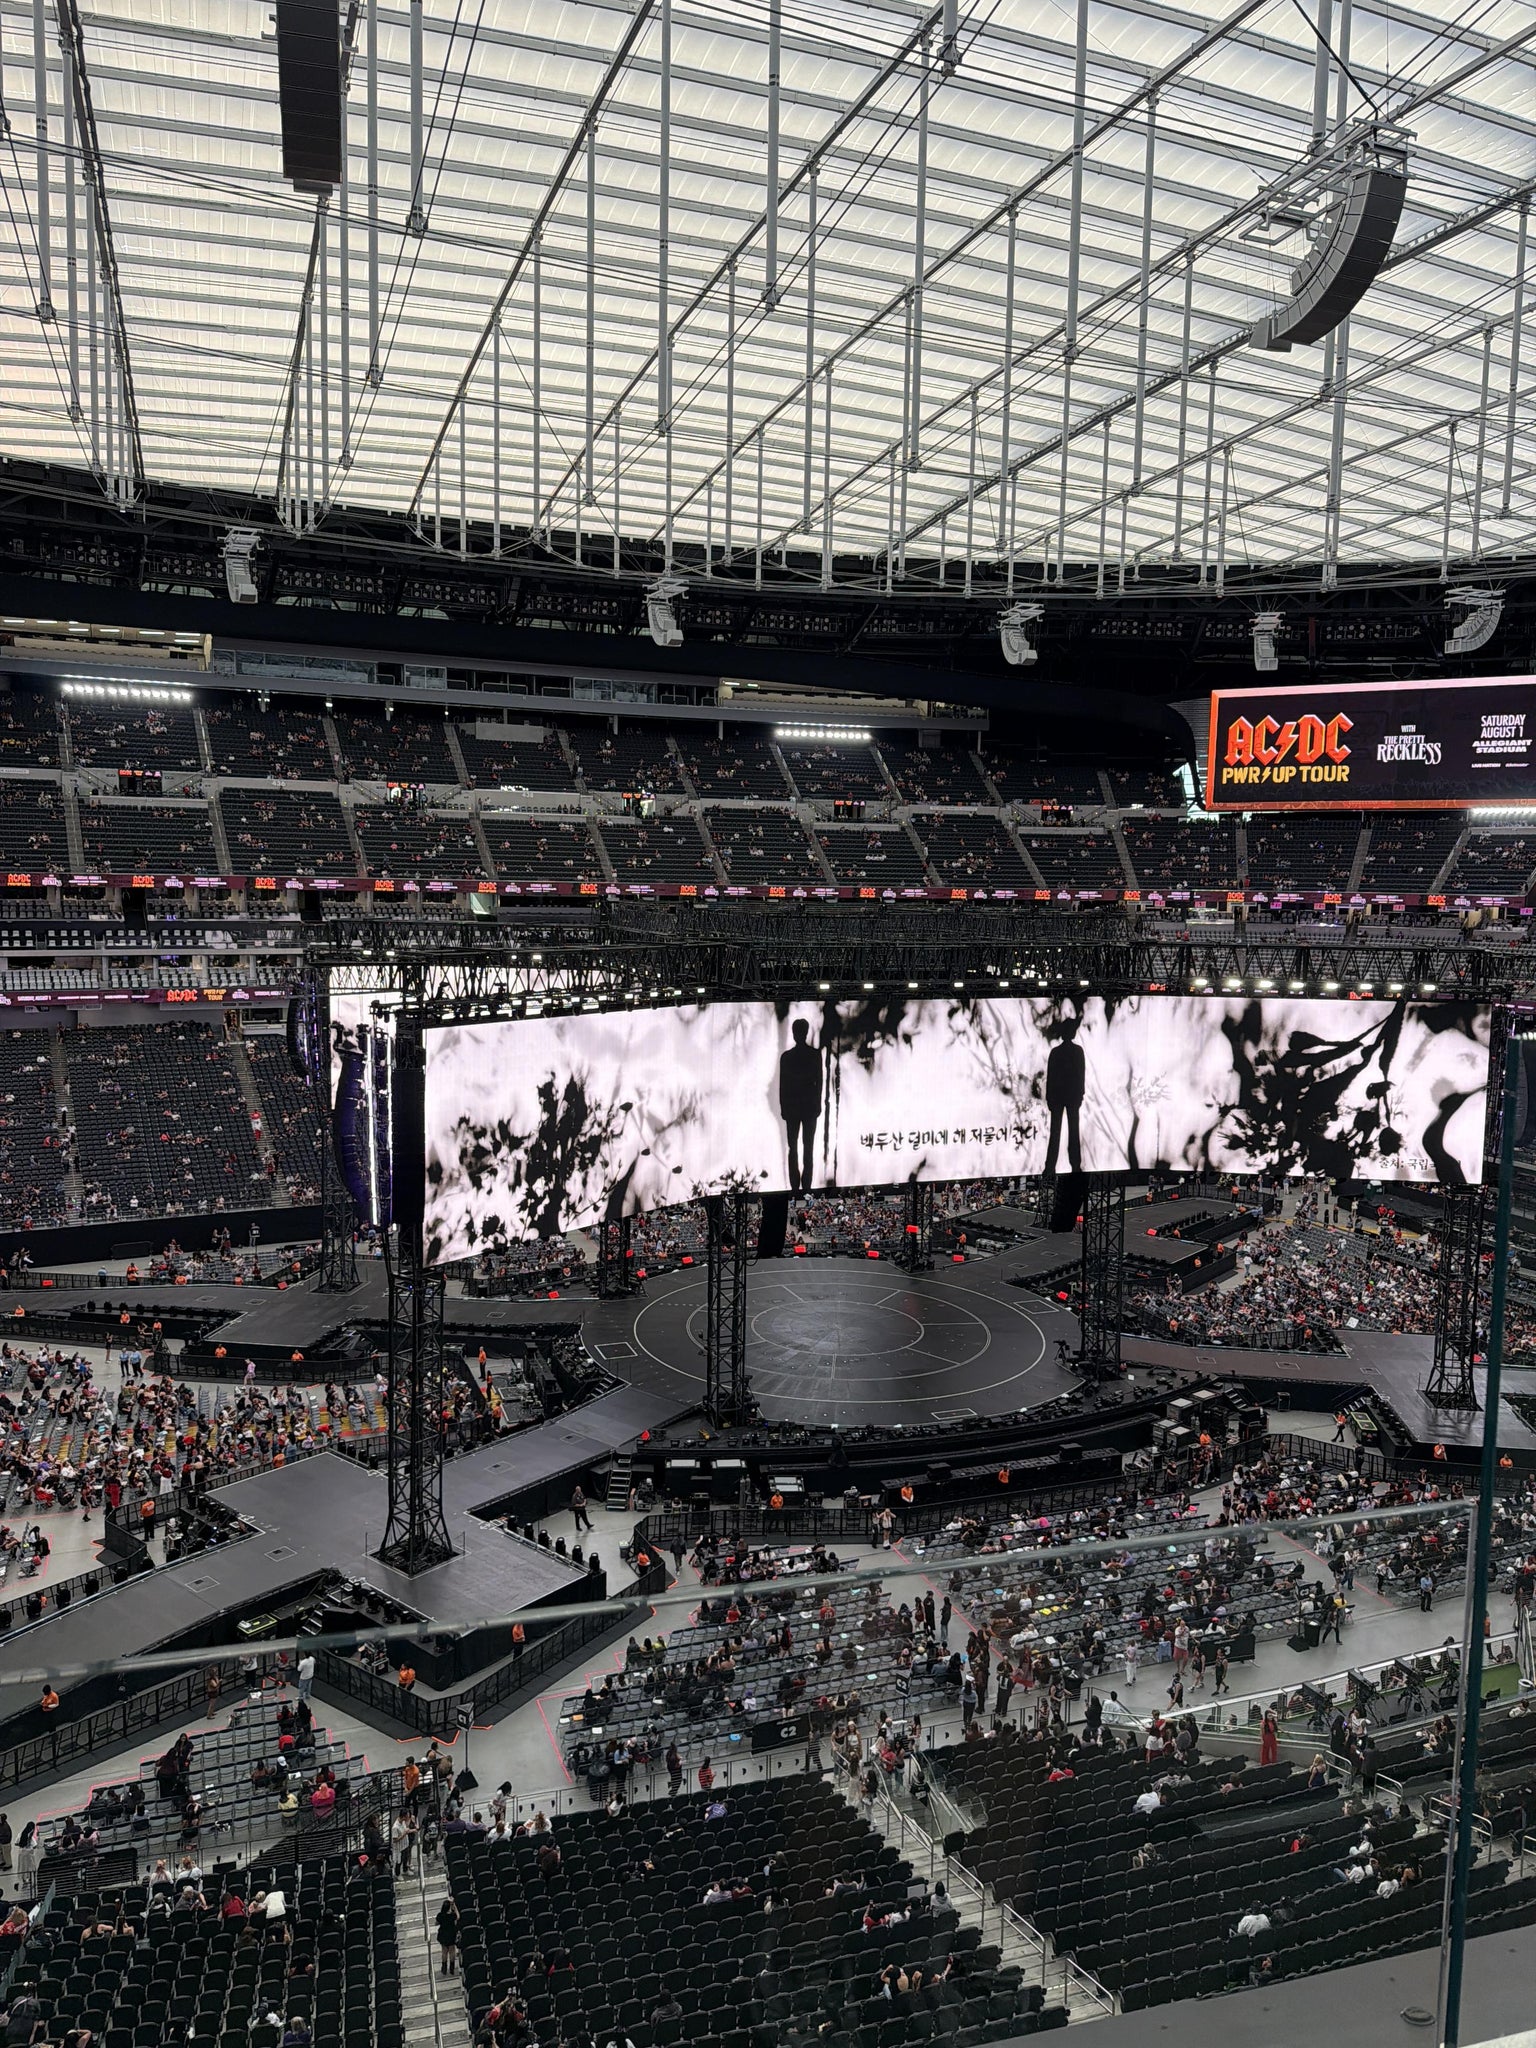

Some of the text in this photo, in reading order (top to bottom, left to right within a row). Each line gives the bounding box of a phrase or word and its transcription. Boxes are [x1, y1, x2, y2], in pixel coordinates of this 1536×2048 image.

[1480, 714, 1526, 727] SATURDAY
[1401, 725, 1416, 733] WITH
[1480, 726, 1524, 739] AUGUST 1
[1384, 735, 1426, 745] THE PRETTY
[1472, 739, 1533, 747] ALLEGIANT
[1377, 742, 1442, 765] RECKLESS
[1476, 746, 1527, 754] STADIUM
[1299, 765, 1350, 783] TOUR
[860, 1132, 903, 1152] 백두산
[908, 1129, 949, 1151] 덜미에
[953, 1127, 966, 1144] 해
[969, 1126, 1008, 1146] 저물어
[896, 1678, 907, 1690] C2
[458, 1713, 467, 1725] C1
[780, 1725, 797, 1738] C2
